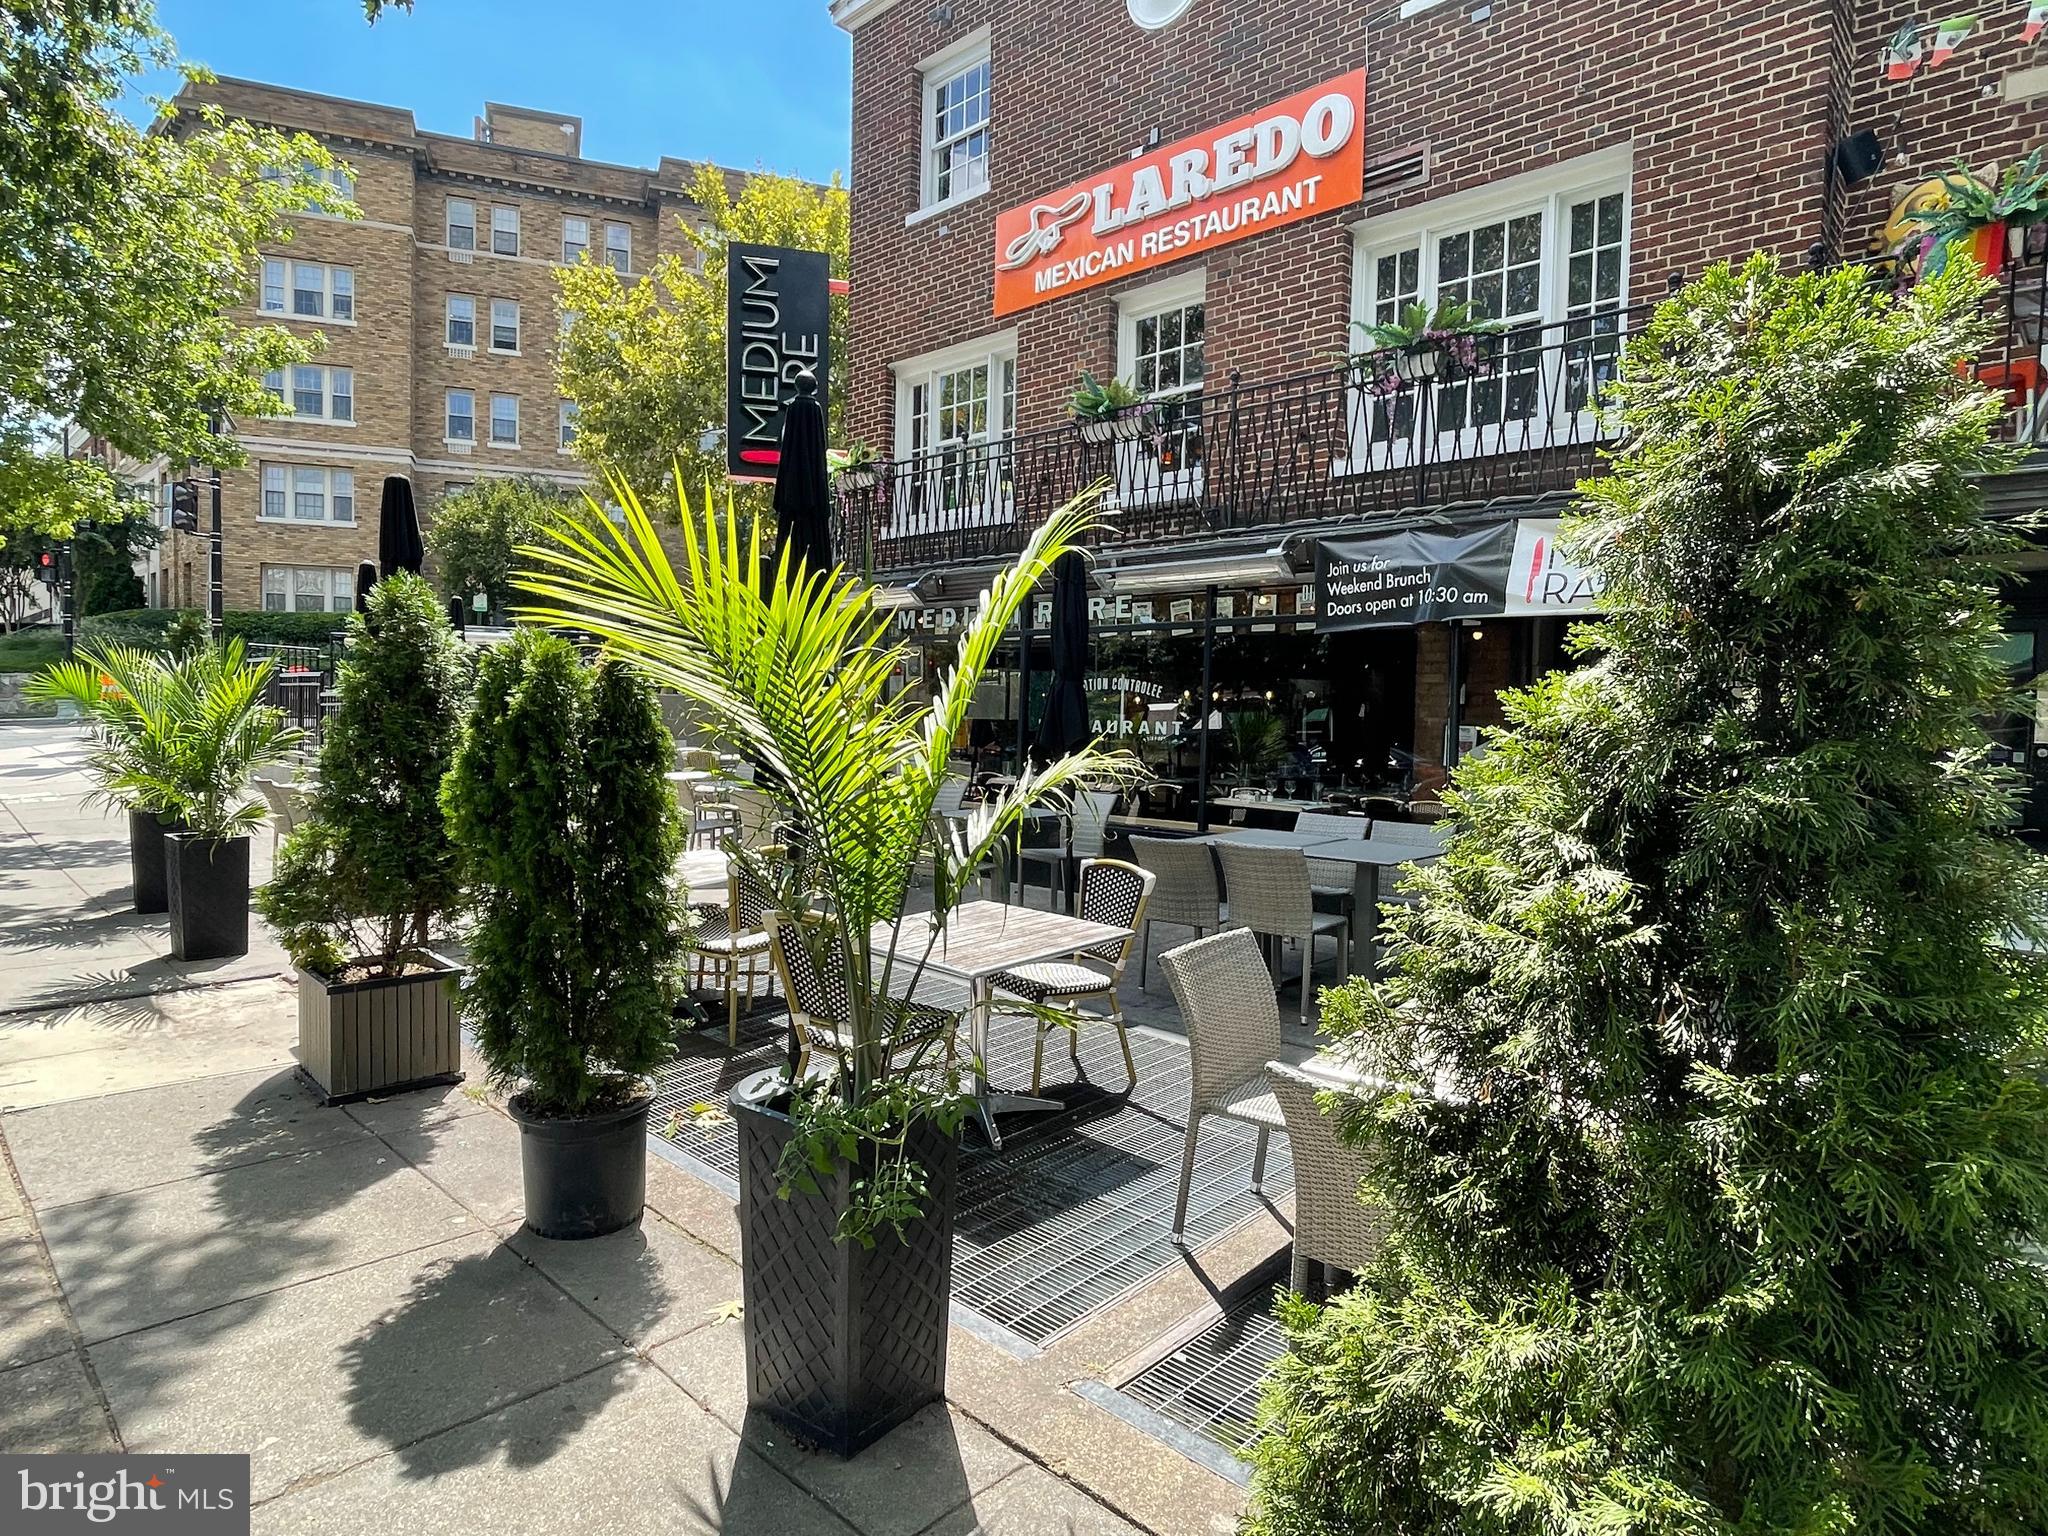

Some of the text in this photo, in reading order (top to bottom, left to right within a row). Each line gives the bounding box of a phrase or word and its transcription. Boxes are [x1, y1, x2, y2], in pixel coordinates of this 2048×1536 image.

[1091, 93, 1355, 236] LAREDO
[1034, 176, 1322, 294] MEXICAN RESTAURANT
[741, 256, 780, 442] MEDIUM
[1327, 555, 1391, 578] Join us for
[1327, 577, 1383, 597] Weekend
[1386, 566, 1431, 589] Brunch
[897, 595, 1133, 630] MEDI RRE
[1327, 586, 1489, 617] Doors open at 10:30 am
[1091, 719, 1184, 736] AURANT
